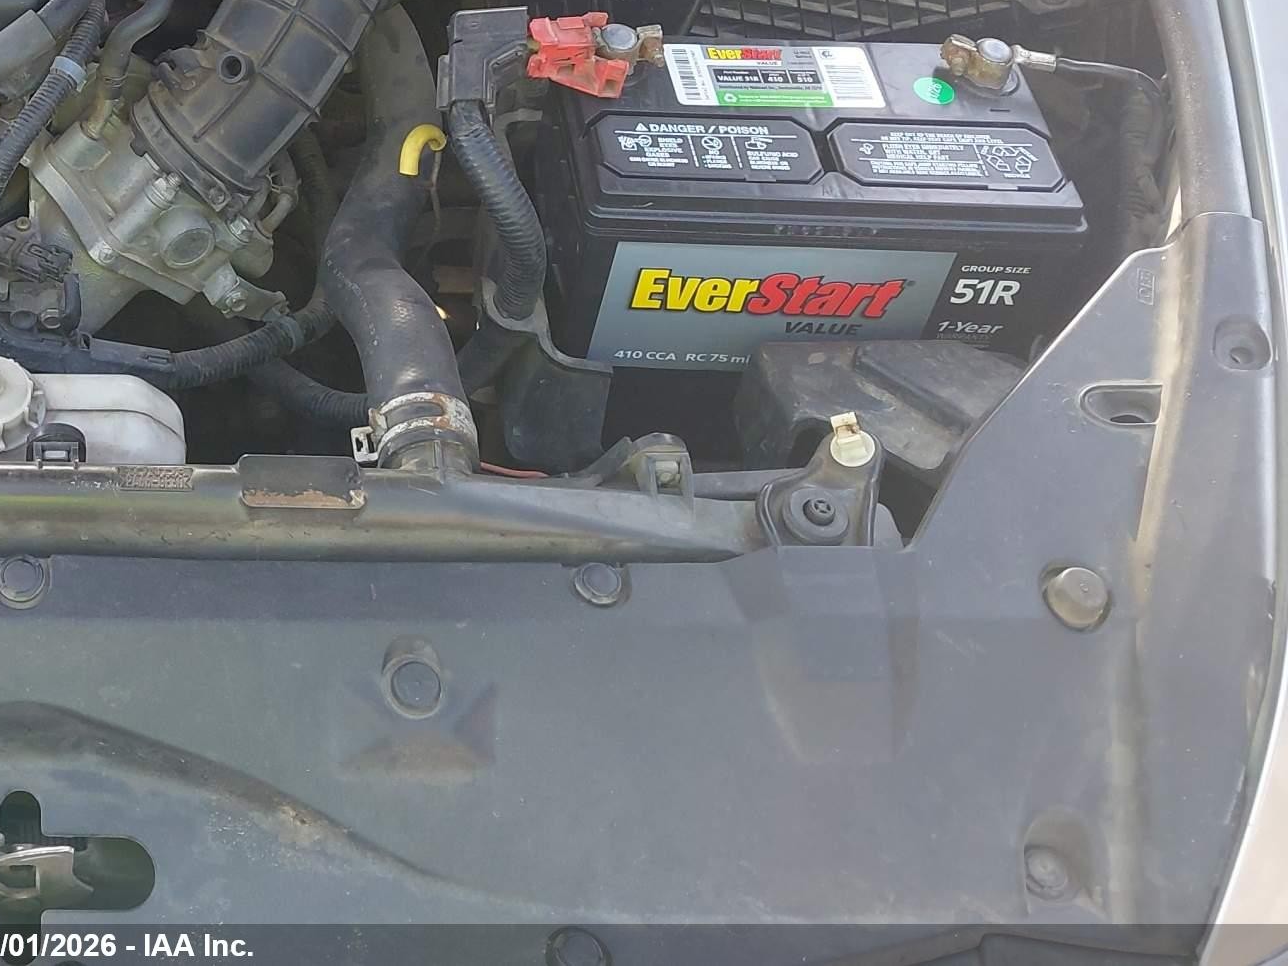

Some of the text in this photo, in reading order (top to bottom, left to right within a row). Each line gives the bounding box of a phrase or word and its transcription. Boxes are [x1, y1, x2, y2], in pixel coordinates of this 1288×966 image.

[706, 46, 782, 61] EverStart
[648, 123, 706, 133] DANGER
[718, 125, 769, 135] POISON
[961, 265, 1032, 274] GROUP SIZE
[629, 267, 907, 318] EverStart
[950, 278, 1021, 305] 51R
[785, 321, 863, 335] VALUE
[938, 320, 1004, 334] 1-Year
[614, 350, 643, 360] 410
[645, 351, 677, 361] CCA
[686, 353, 707, 362] RC
[709, 353, 729, 363] 75
